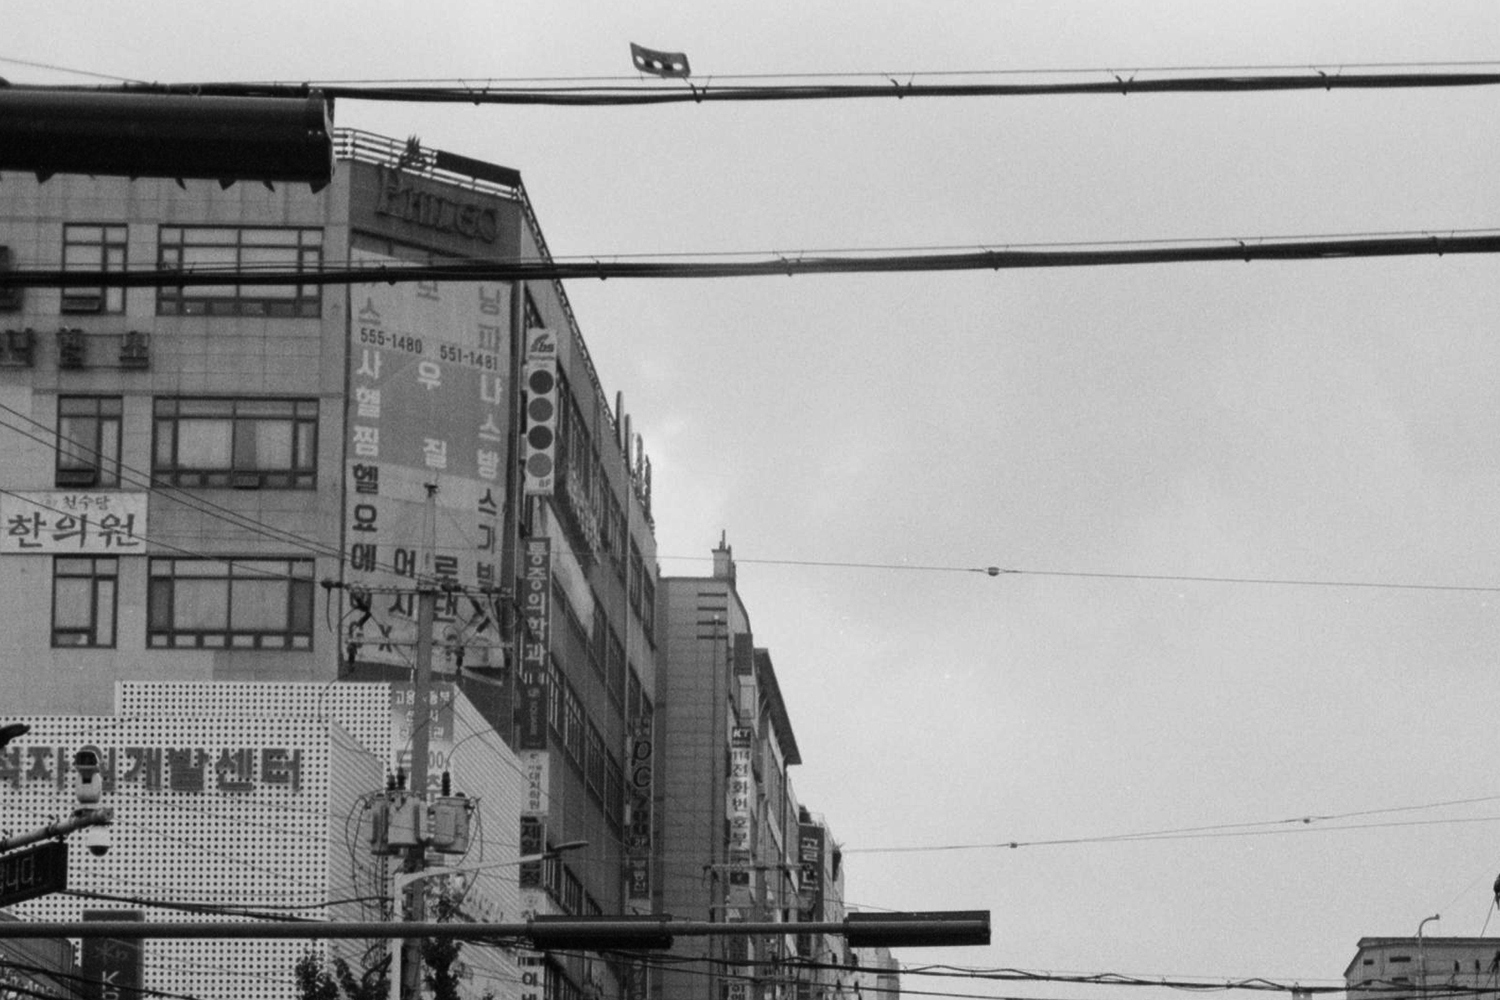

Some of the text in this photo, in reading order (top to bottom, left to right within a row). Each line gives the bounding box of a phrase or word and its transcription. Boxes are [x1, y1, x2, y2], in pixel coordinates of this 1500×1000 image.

[361, 328, 423, 355] 555-1480
[440, 345, 498, 372] 551-1481
[8, 511, 139, 549] 한의원
